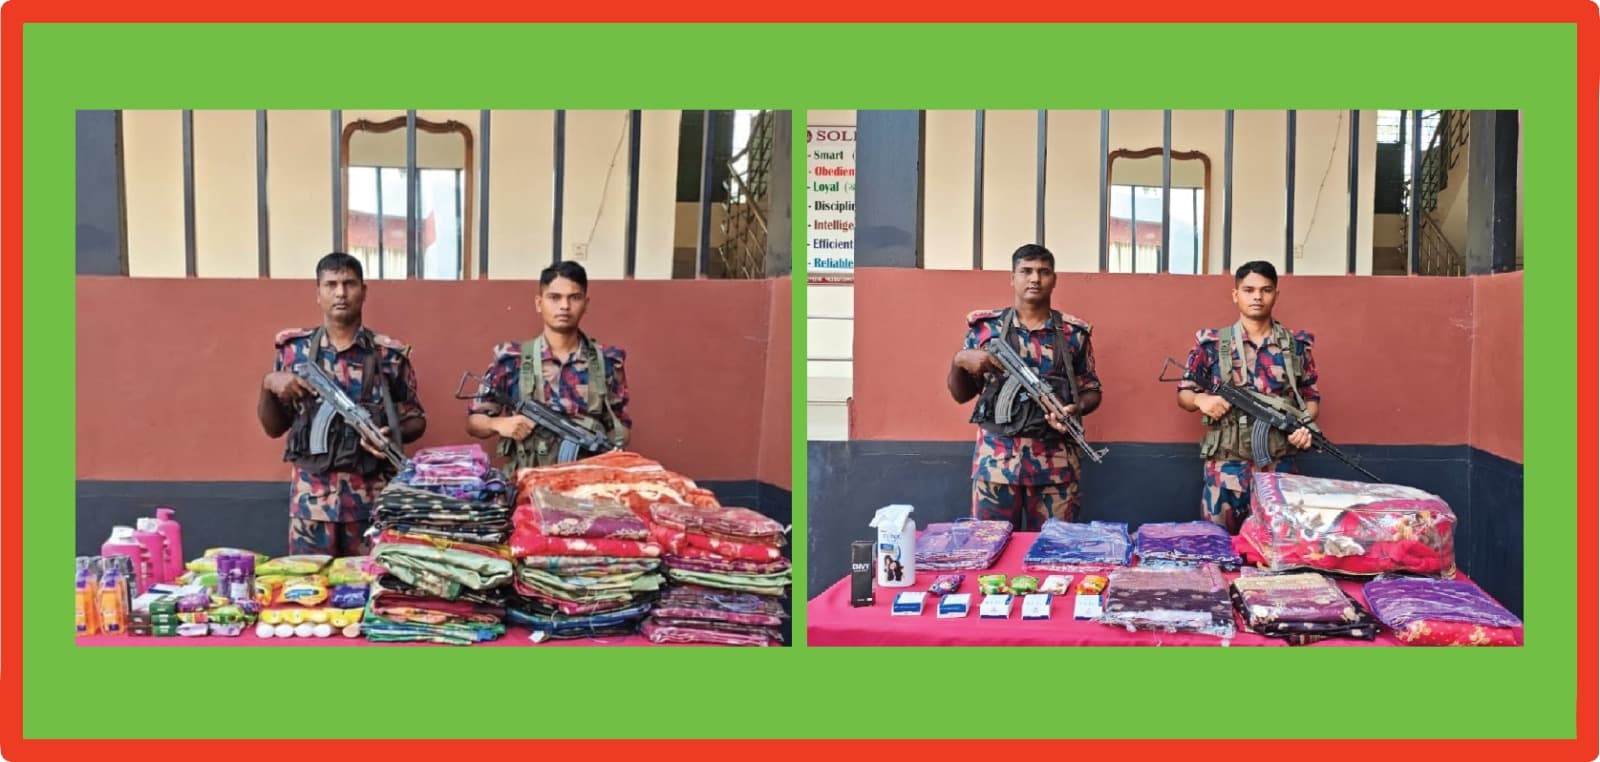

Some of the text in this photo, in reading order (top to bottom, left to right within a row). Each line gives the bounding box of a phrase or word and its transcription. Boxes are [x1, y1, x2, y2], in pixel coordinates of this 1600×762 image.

[814, 150, 843, 160] Smart
[813, 181, 839, 194] Loyal
[813, 238, 854, 249] Efficient
[814, 258, 854, 268] Reliable
